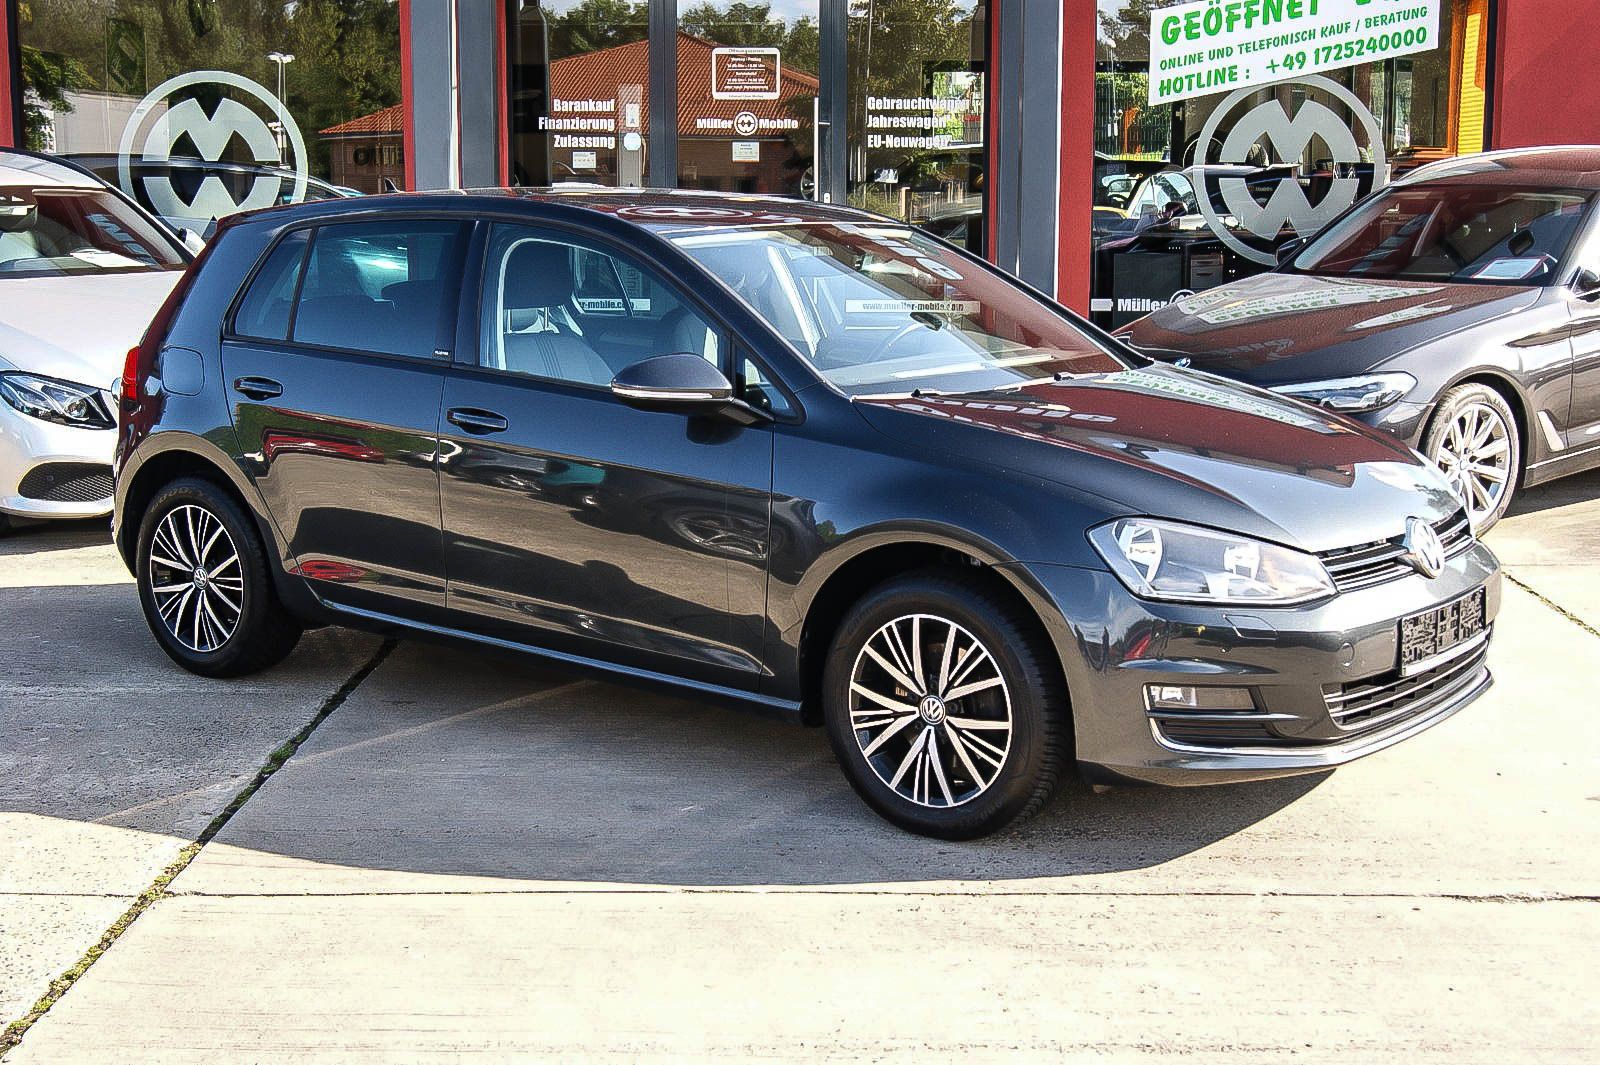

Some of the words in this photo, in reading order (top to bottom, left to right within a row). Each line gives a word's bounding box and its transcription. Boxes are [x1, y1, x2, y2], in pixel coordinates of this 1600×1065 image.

[1160, 52, 1204, 71] ONLINE
[1208, 46, 1234, 61] UND
[1237, 29, 1316, 55] TELEFONISCH
[1321, 21, 1352, 38] KAUF
[1365, 6, 1428, 29] BERATUNG
[1158, 65, 1238, 97] HOTLINE
[1266, 51, 1307, 74] +49
[1314, 26, 1428, 65] 1725240000
[553, 98, 615, 112] Barankauf
[538, 116, 615, 131] Finanzierung
[759, 118, 799, 129] Mobile
[867, 115, 947, 129] Jahreswagen
[553, 134, 615, 149] Zulassung
[867, 134, 948, 149] EU-Neuwagen
[1117, 298, 1168, 312] Müller
